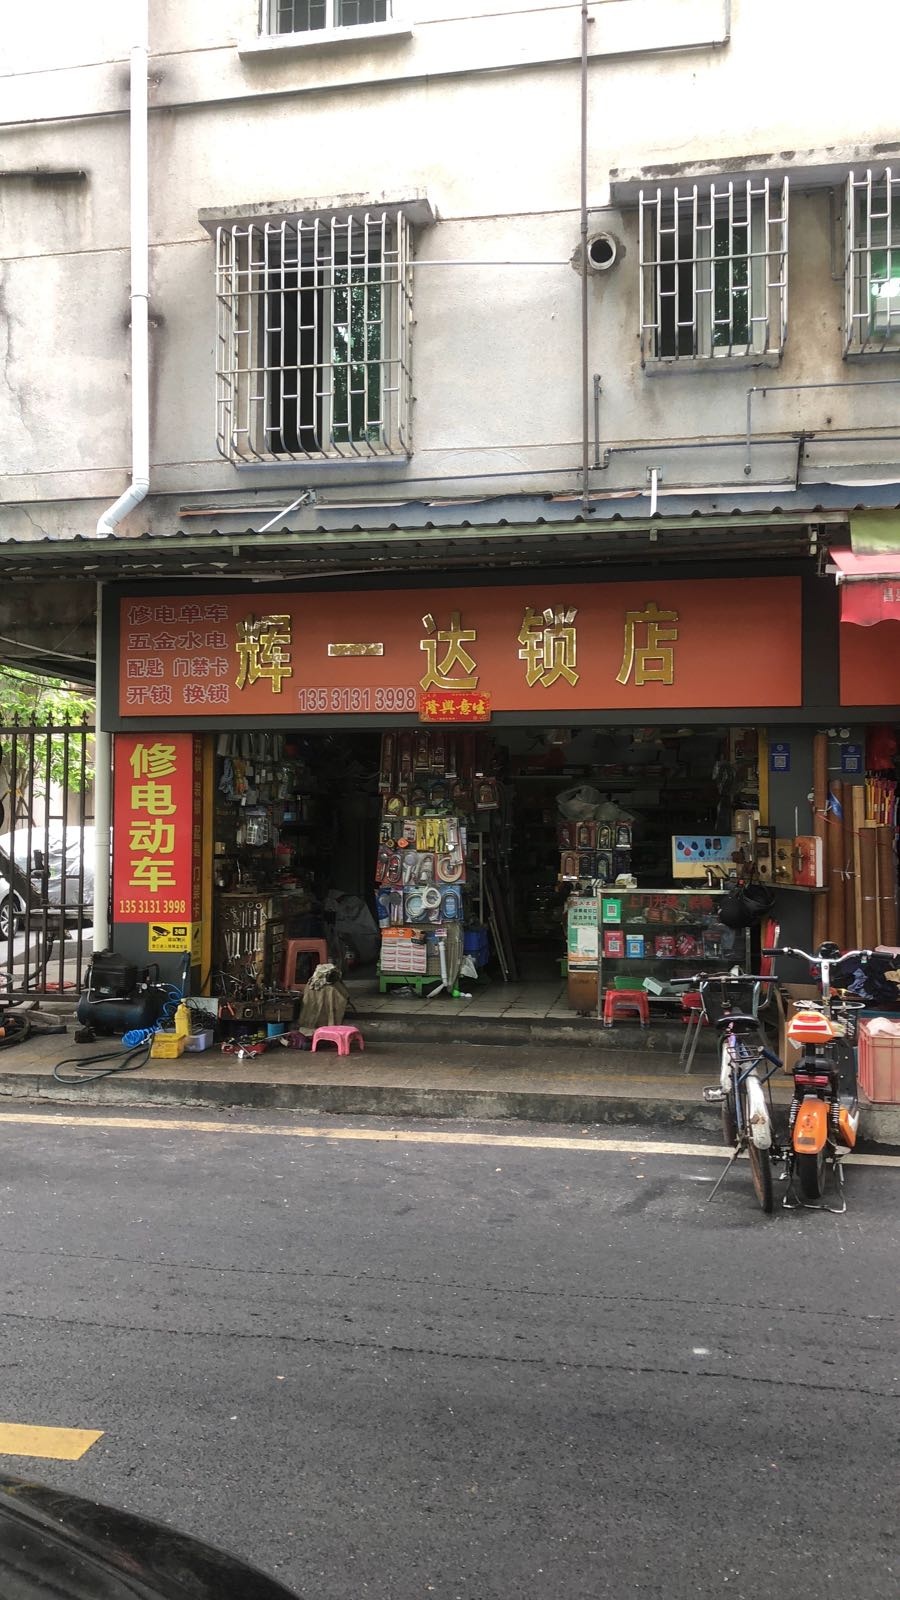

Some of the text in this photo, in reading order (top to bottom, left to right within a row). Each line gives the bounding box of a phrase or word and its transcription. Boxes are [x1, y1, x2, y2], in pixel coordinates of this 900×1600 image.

[128, 604, 228, 625] 修电单车
[128, 631, 228, 650] 五金水电
[235, 601, 679, 694] 辉一达锁店
[127, 657, 228, 678] 配匙 门禁卡
[127, 683, 230, 705] 开锁 换锁
[298, 687, 417, 711] 135 3131 3998
[129, 743, 177, 893] 修电动车
[119, 899, 186, 914] 135 3131 3998
